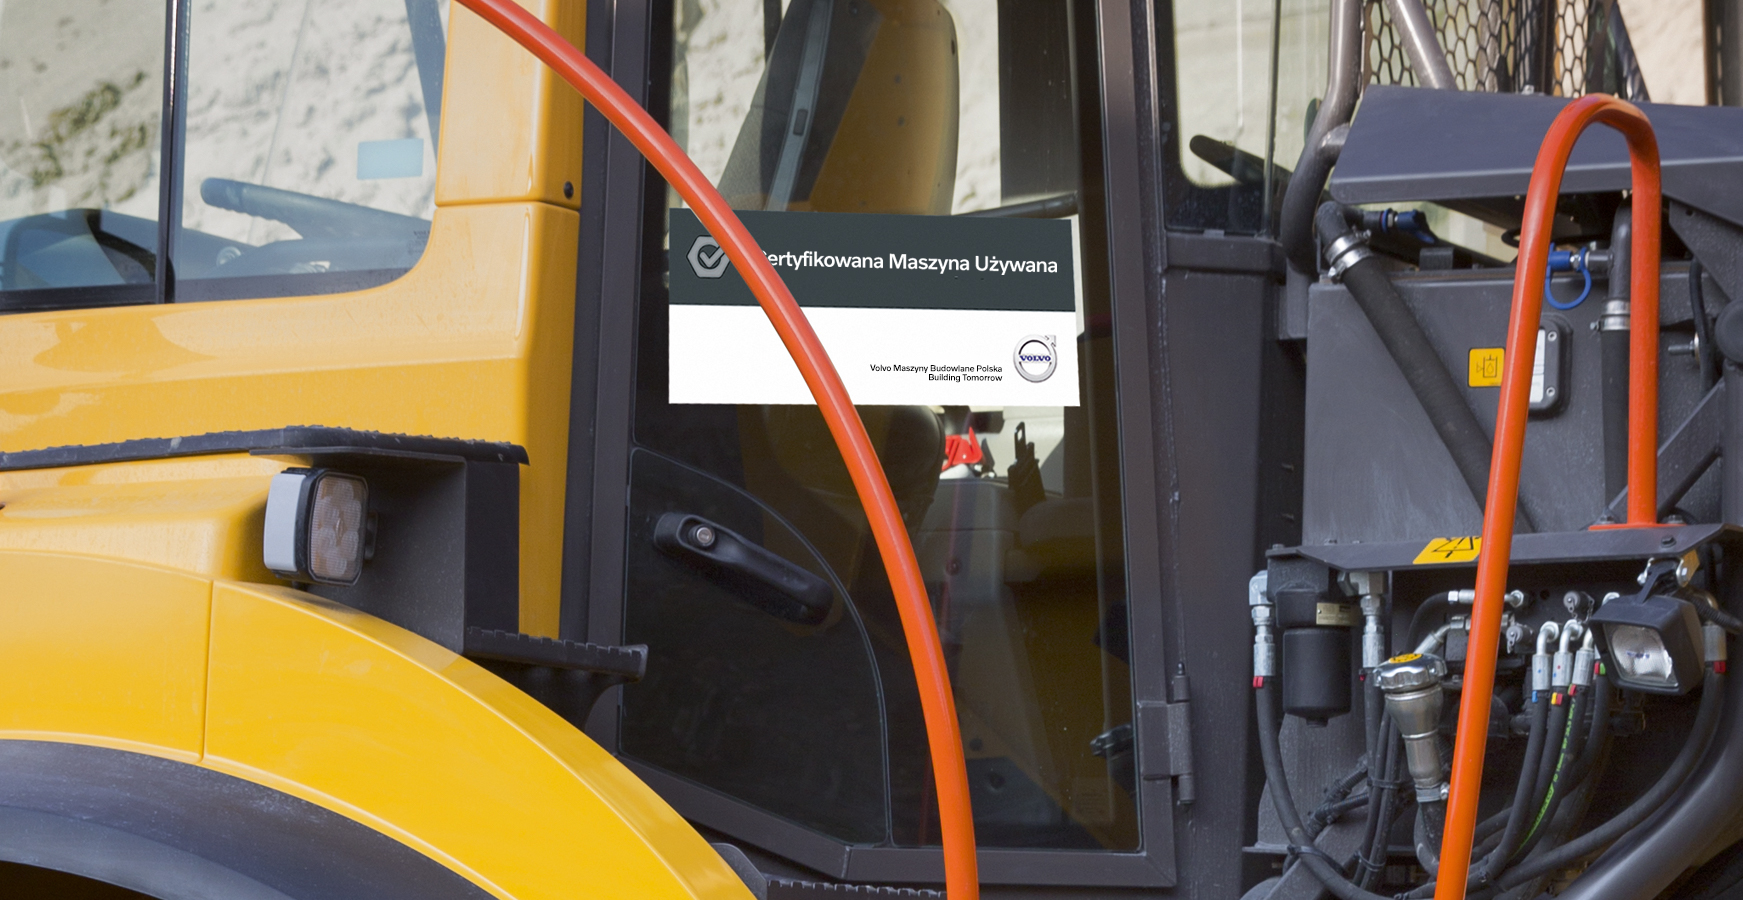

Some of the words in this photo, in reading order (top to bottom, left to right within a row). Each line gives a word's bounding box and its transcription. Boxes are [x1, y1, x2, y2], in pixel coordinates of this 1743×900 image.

[762, 250, 884, 271] ertyfikowana
[889, 253, 970, 275] Maszyna
[975, 255, 1058, 276] Używana
[869, 363, 892, 372] Volvo
[893, 364, 929, 374] Maszyny
[930, 364, 975, 373] Budowlane
[976, 364, 1003, 373] Polska
[928, 373, 961, 383] Building
[962, 373, 1003, 382] Tomorrow
